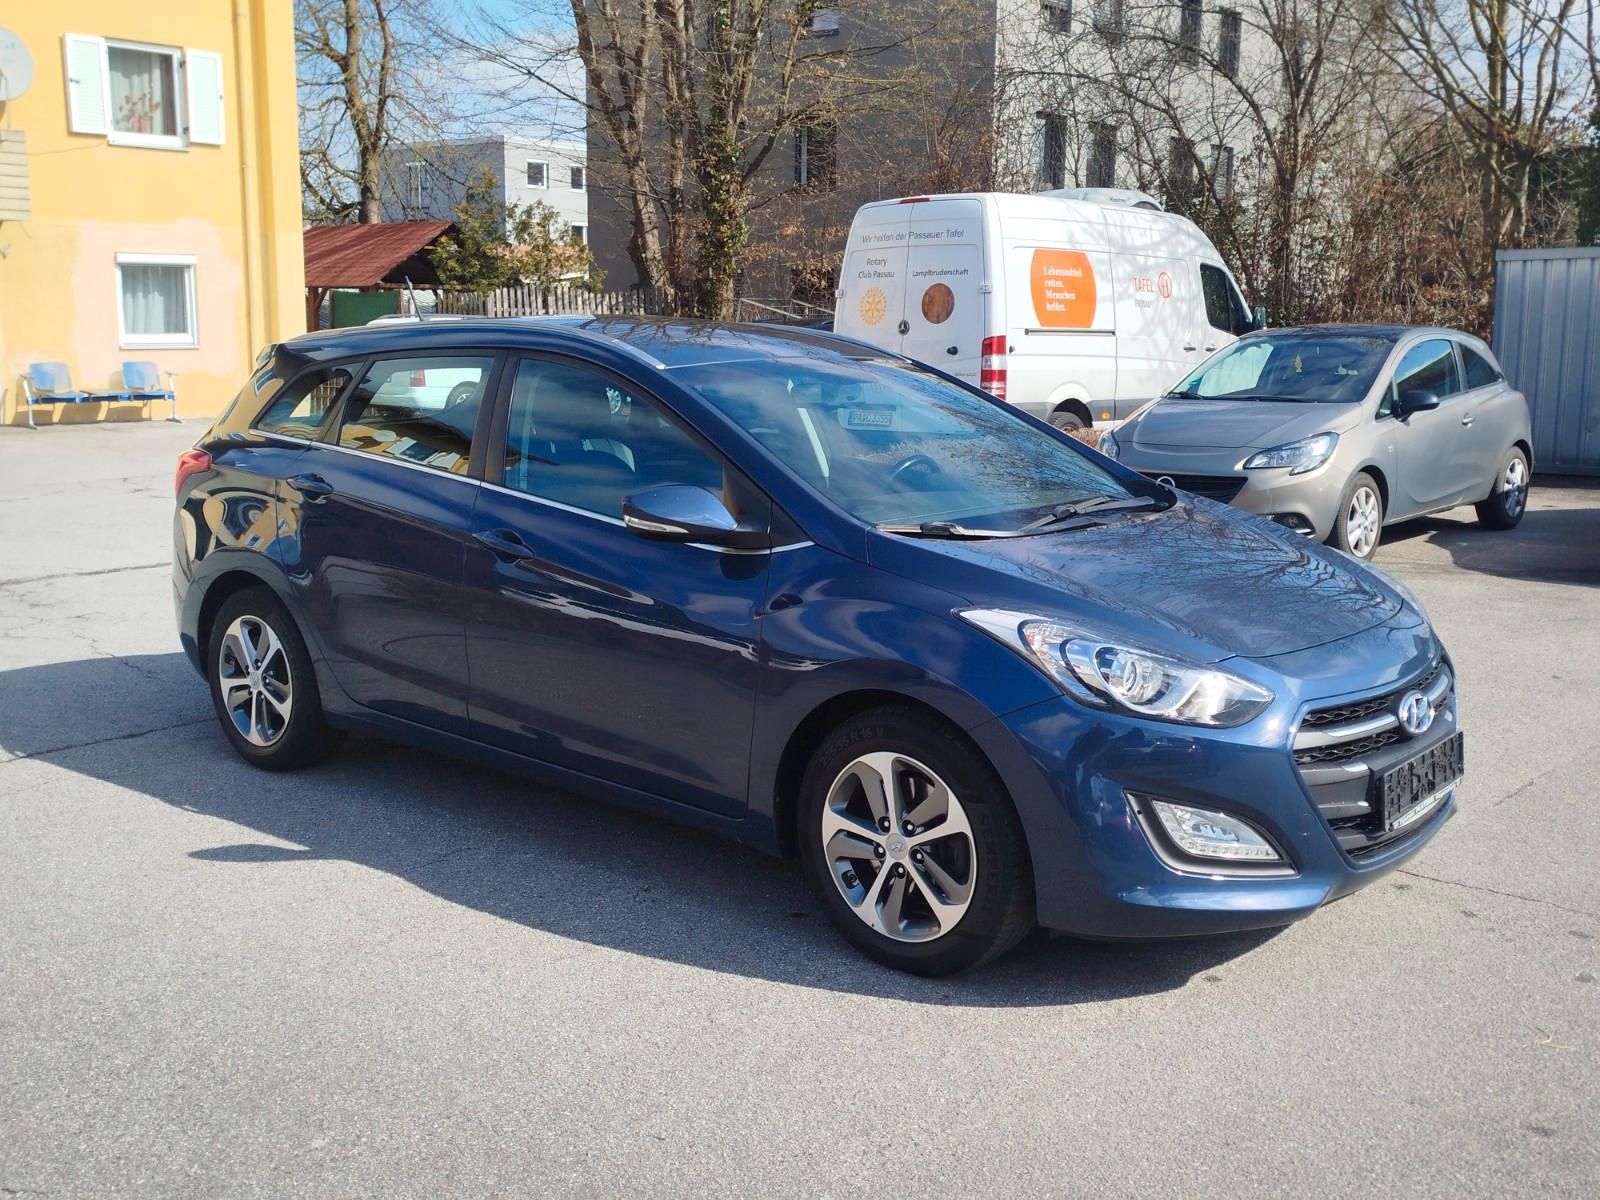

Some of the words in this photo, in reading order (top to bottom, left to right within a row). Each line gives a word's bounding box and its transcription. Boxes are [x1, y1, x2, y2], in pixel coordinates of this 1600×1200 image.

[874, 232, 894, 242] helfen
[896, 231, 907, 241] der
[909, 230, 944, 240] Passauer
[946, 229, 964, 238] Tafel
[866, 258, 887, 267] Rotary
[858, 270, 872, 279] Club
[873, 269, 895, 279] Passau
[1044, 266, 1082, 277] Lebensmittel
[1045, 278, 1065, 288] retten.
[1133, 277, 1154, 292] TAFEL
[1046, 289, 1076, 300] Menschen
[1046, 302, 1066, 312] helfen.
